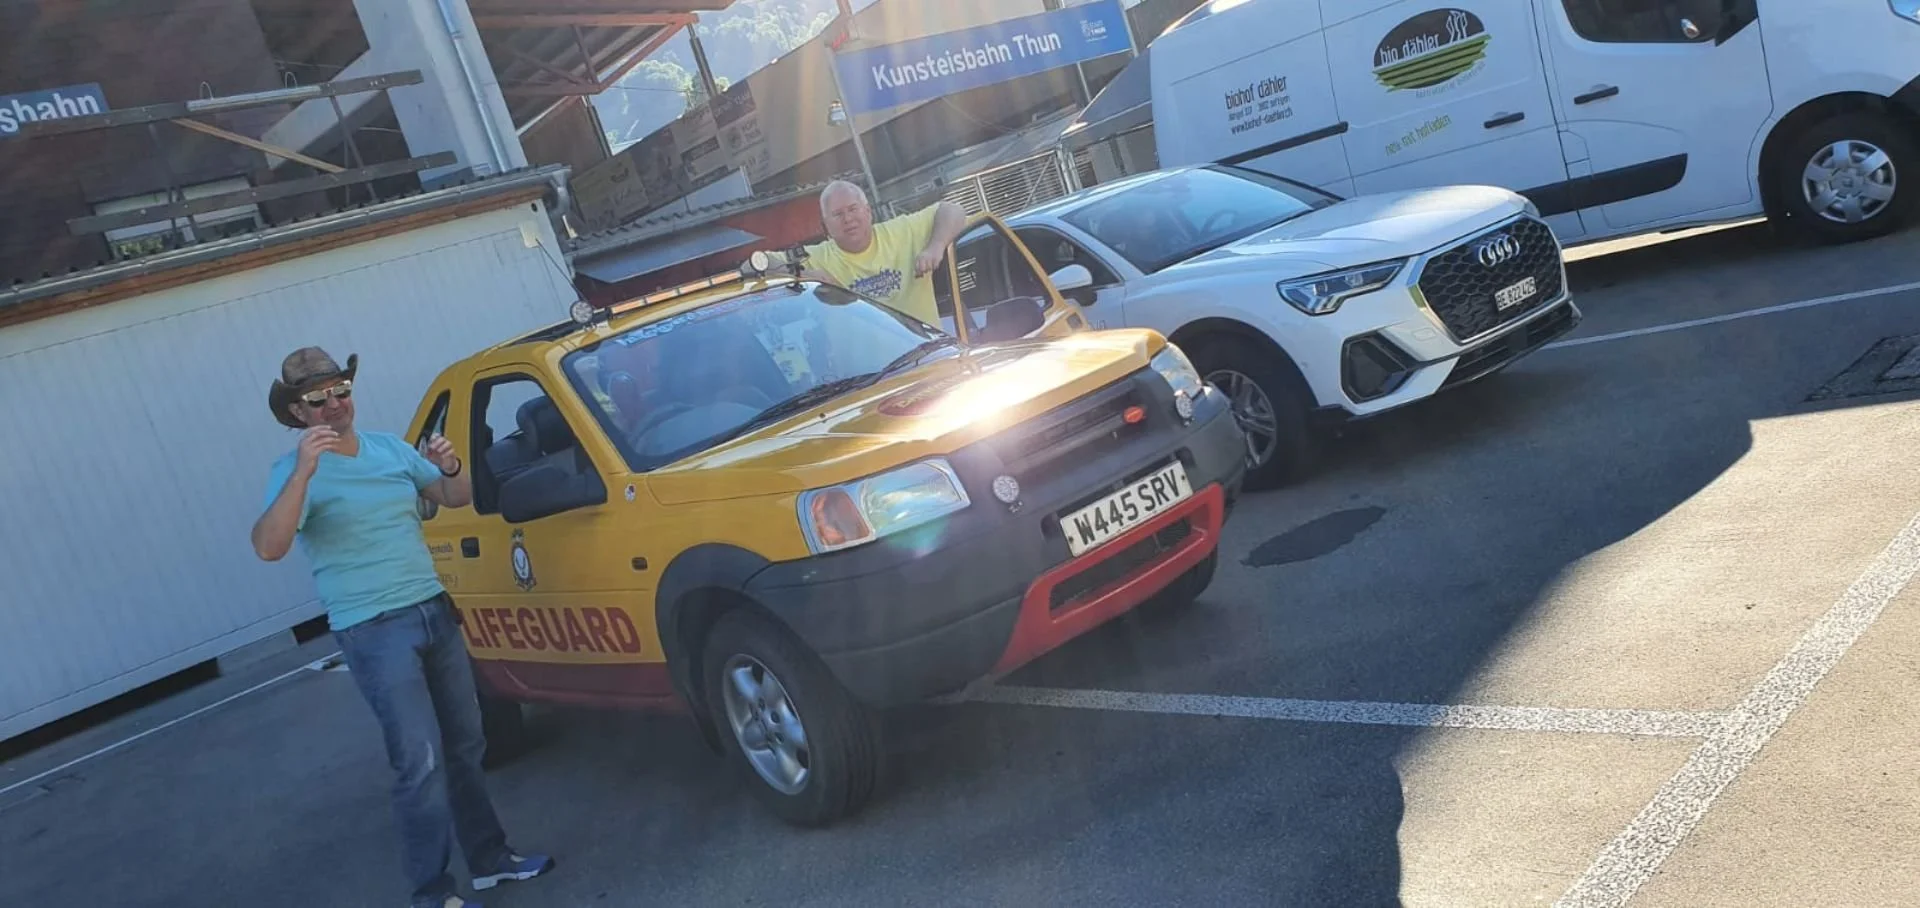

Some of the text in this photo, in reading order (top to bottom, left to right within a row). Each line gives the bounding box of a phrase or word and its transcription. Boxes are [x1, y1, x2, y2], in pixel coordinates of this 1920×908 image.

[872, 32, 1061, 90] Kunsteisbahn Thun
[1380, 33, 1439, 65] bio dähler
[1225, 75, 1287, 110] biohof dähler
[1074, 469, 1180, 545] W445 SRV
[457, 607, 642, 654] LIFEGUARD
